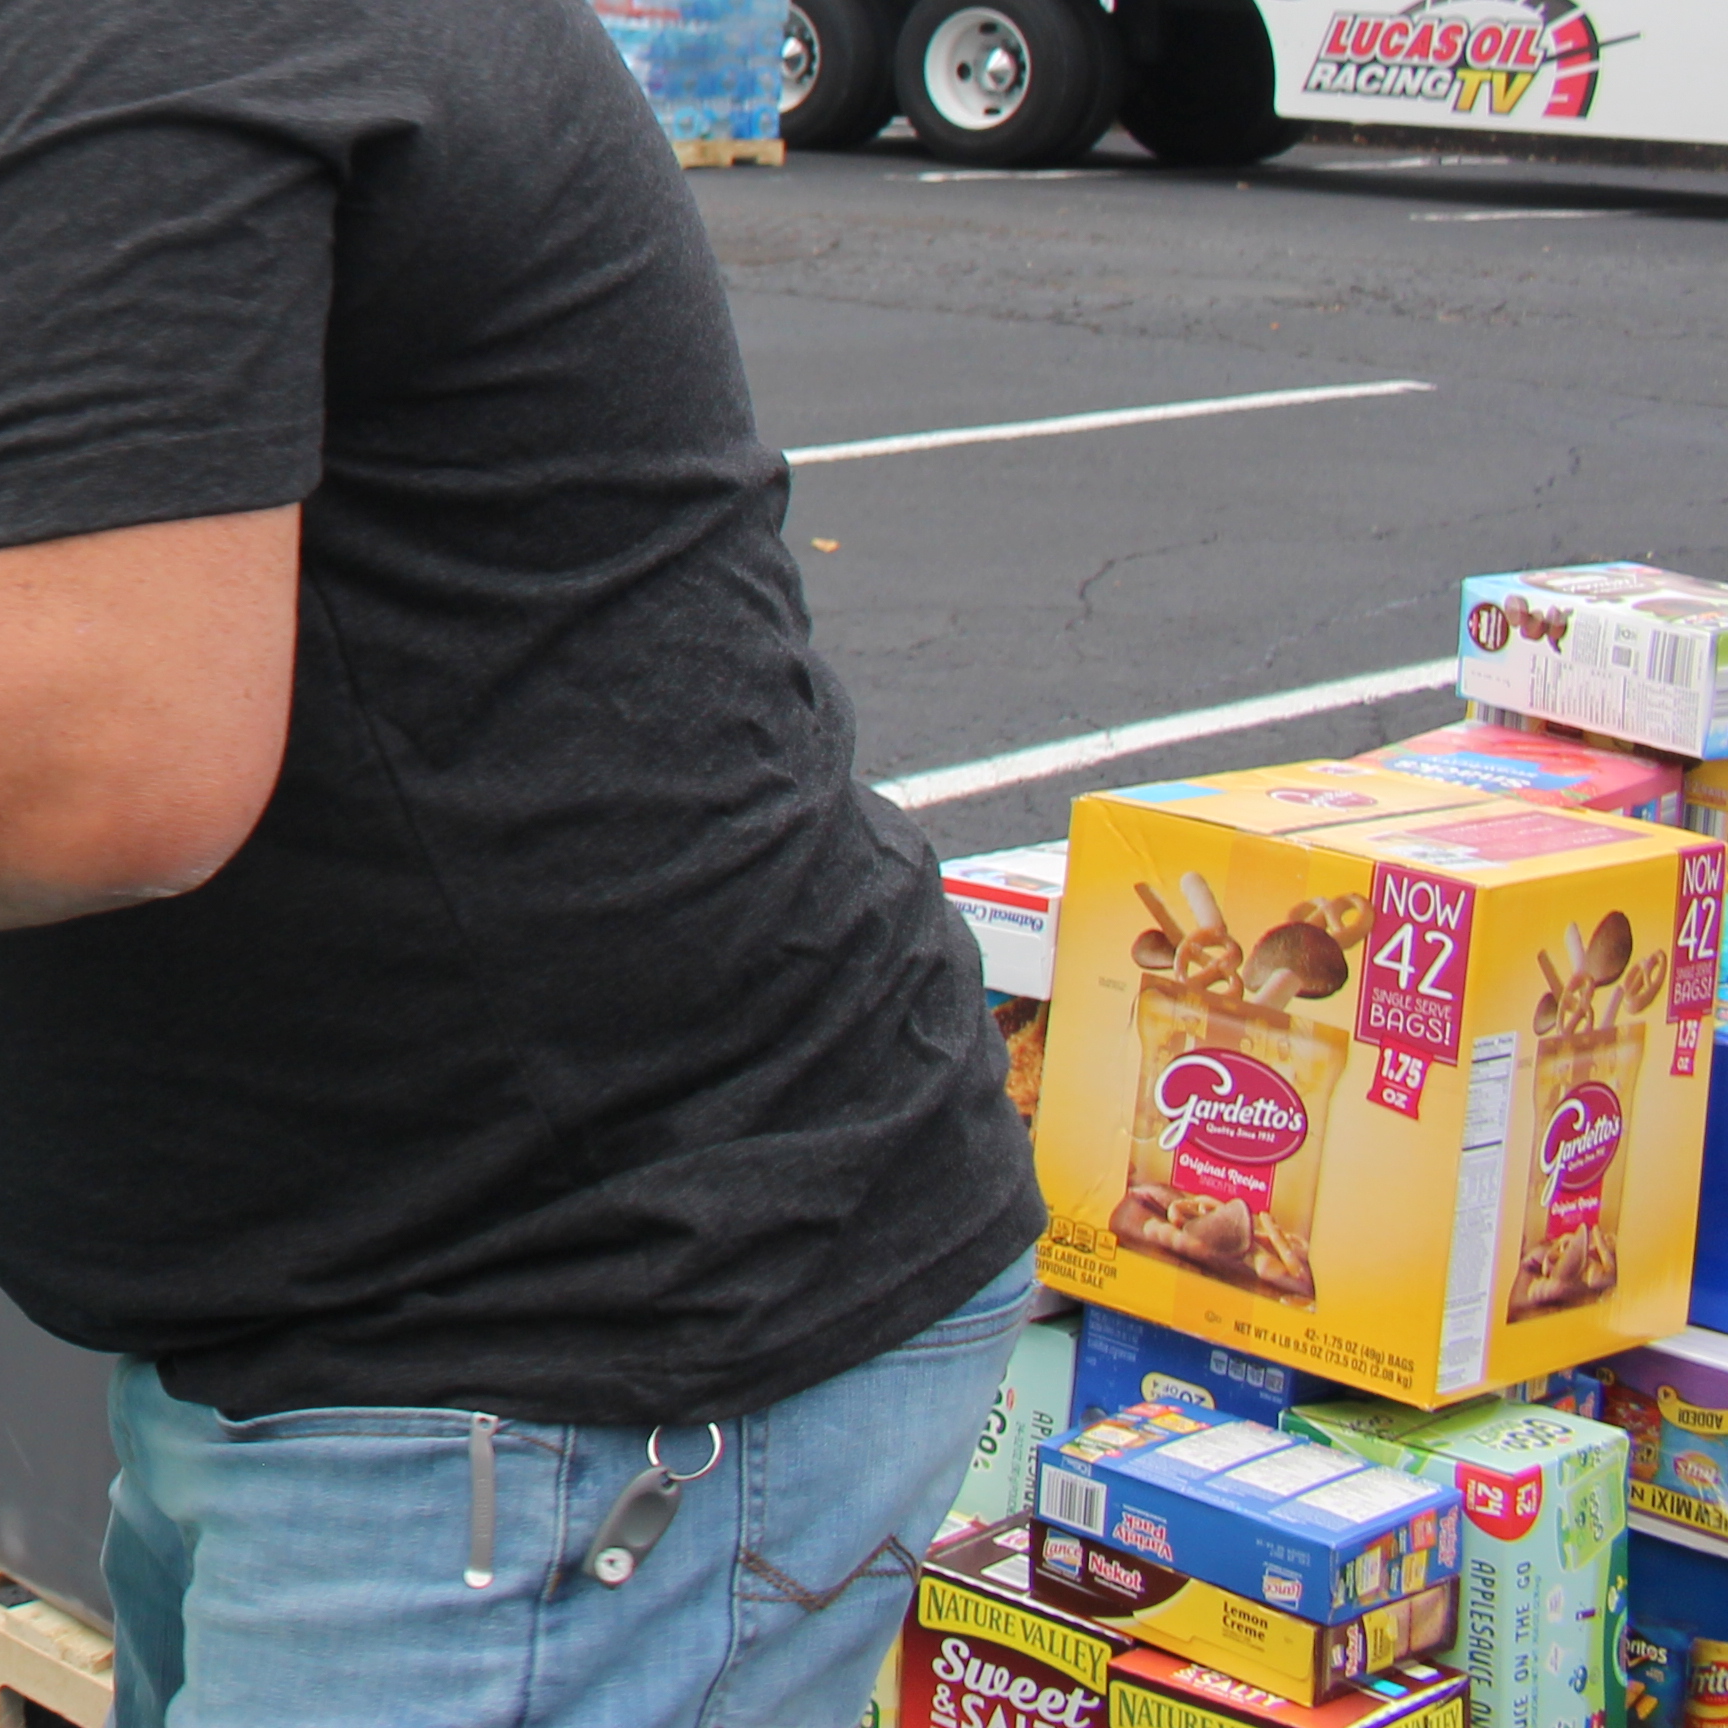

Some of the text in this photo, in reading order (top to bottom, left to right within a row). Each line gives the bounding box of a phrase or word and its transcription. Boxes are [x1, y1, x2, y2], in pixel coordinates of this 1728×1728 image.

[1324, 16, 1545, 70] LUCAS OIL
[1305, 61, 1535, 115] RACING TV
[1682, 852, 1723, 897] NOW
[1382, 873, 1466, 930] NOW
[989, 908, 1044, 933] Oatmeal
[1676, 896, 1716, 962] 42
[1372, 923, 1454, 1000] 42
[1372, 987, 1453, 1020] SINGLE SERVE
[1673, 977, 1713, 1006] BAGS!
[1369, 1003, 1453, 1046] BAGS!
[1381, 1048, 1423, 1089] 1.75
[1154, 1054, 1305, 1151] Gardetto's
[1382, 1088, 1409, 1110] OZ
[1205, 1123, 1235, 1138] Quality
[1236, 1127, 1256, 1141] Since
[1539, 1098, 1621, 1208] Gardetto's
[1179, 1153, 1267, 1192] Original Recipe
[1551, 1201, 1577, 1217] Original
[1054, 1247, 1096, 1272] LABELED
[1098, 1263, 1118, 1280] FOR
[1079, 1271, 1105, 1290] SALE
[1233, 1320, 1414, 1389] NET WT 4 LB 9.5 OZ (73.5 OZ) (2.08 kg)
[1322, 1333, 1344, 1350] 1.75
[1345, 1339, 1359, 1354] OZ
[1360, 1342, 1386, 1365] (49g)
[1387, 1352, 1415, 1372] BAGS
[1677, 1408, 1724, 1430] ADDED!
[1477, 1479, 1505, 1517] 24
[1516, 1484, 1533, 1516] 24
[1651, 1489, 1692, 1519] MIX!
[1112, 1523, 1174, 1562] Variety
[1122, 1511, 1167, 1541] Pack
[1044, 1538, 1083, 1559] Lance
[1088, 1551, 1143, 1592] Nekot
[1263, 1575, 1303, 1600] Lance
[1516, 1560, 1531, 1589] GO
[1222, 1600, 1269, 1629] Lemon
[1222, 1614, 1266, 1642] Creme
[1468, 1558, 1495, 1688] APPLESAUCE
[1515, 1602, 1530, 1643] THE
[926, 1583, 1106, 1684] NATURE VALLEY
[931, 1637, 1101, 1728] Sweet
[1514, 1653, 1529, 1683] ON
[929, 1683, 957, 1719] &
[1199, 1672, 1288, 1706] SALTY
